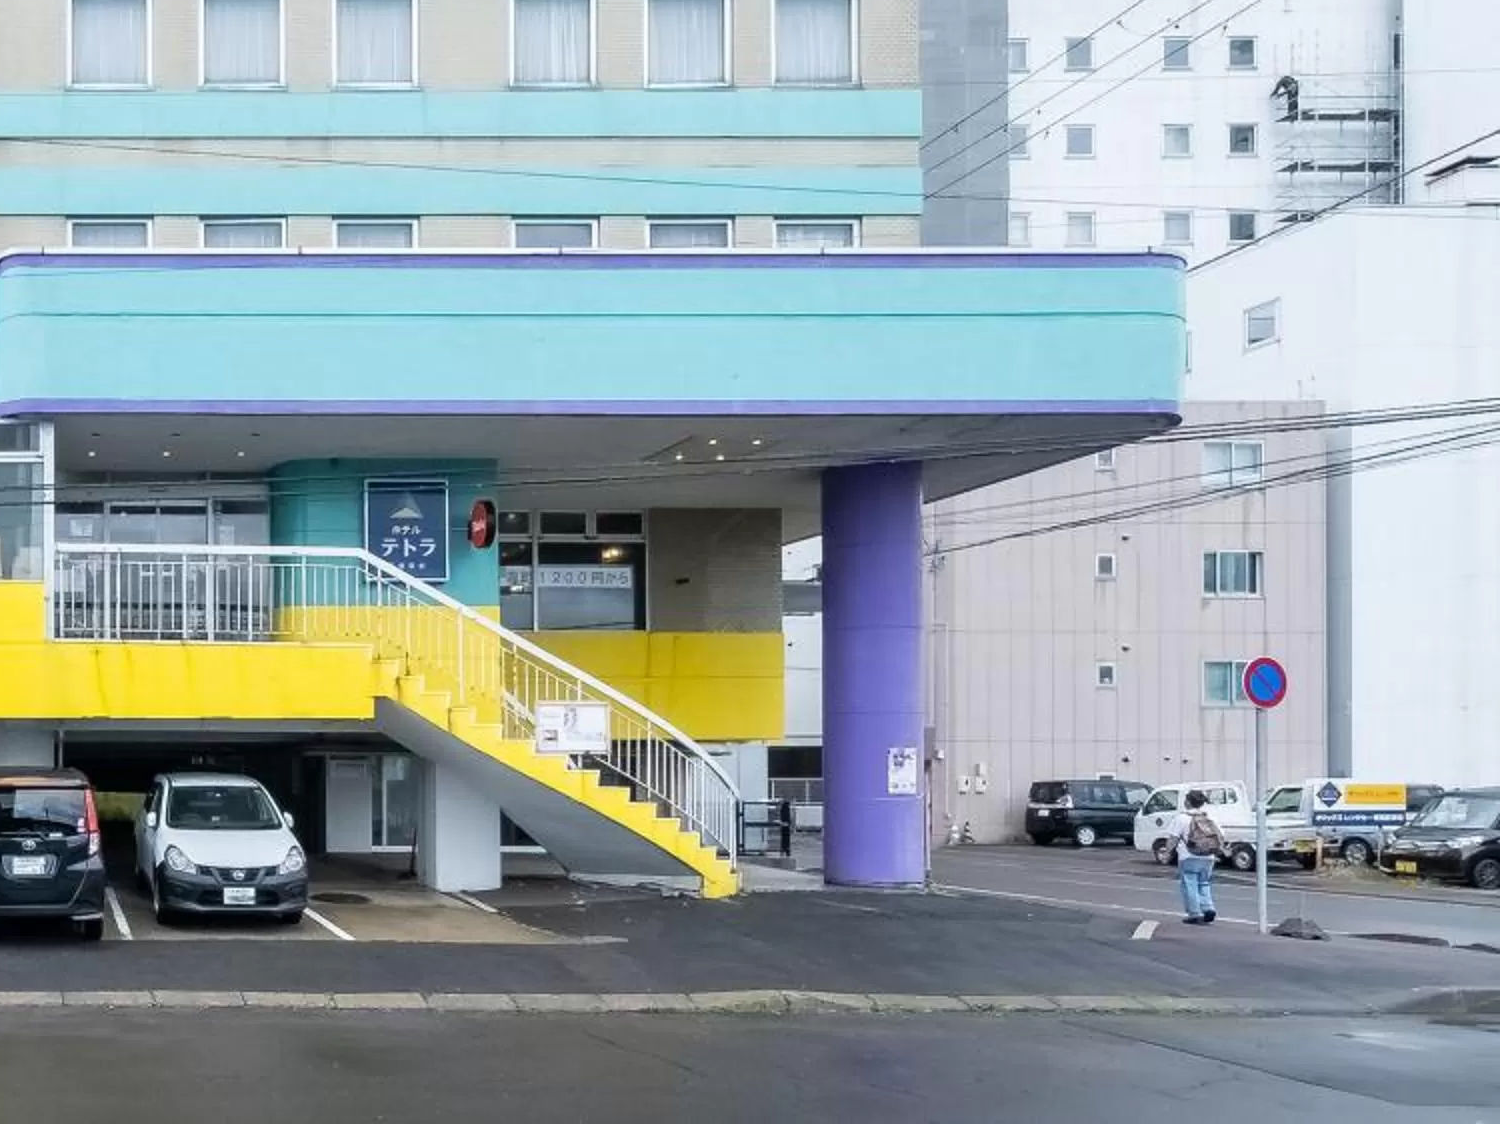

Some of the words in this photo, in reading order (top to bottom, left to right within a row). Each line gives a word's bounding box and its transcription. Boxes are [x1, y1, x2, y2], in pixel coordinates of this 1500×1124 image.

[391, 524, 421, 535] ホテル
[380, 537, 437, 558] テトラ
